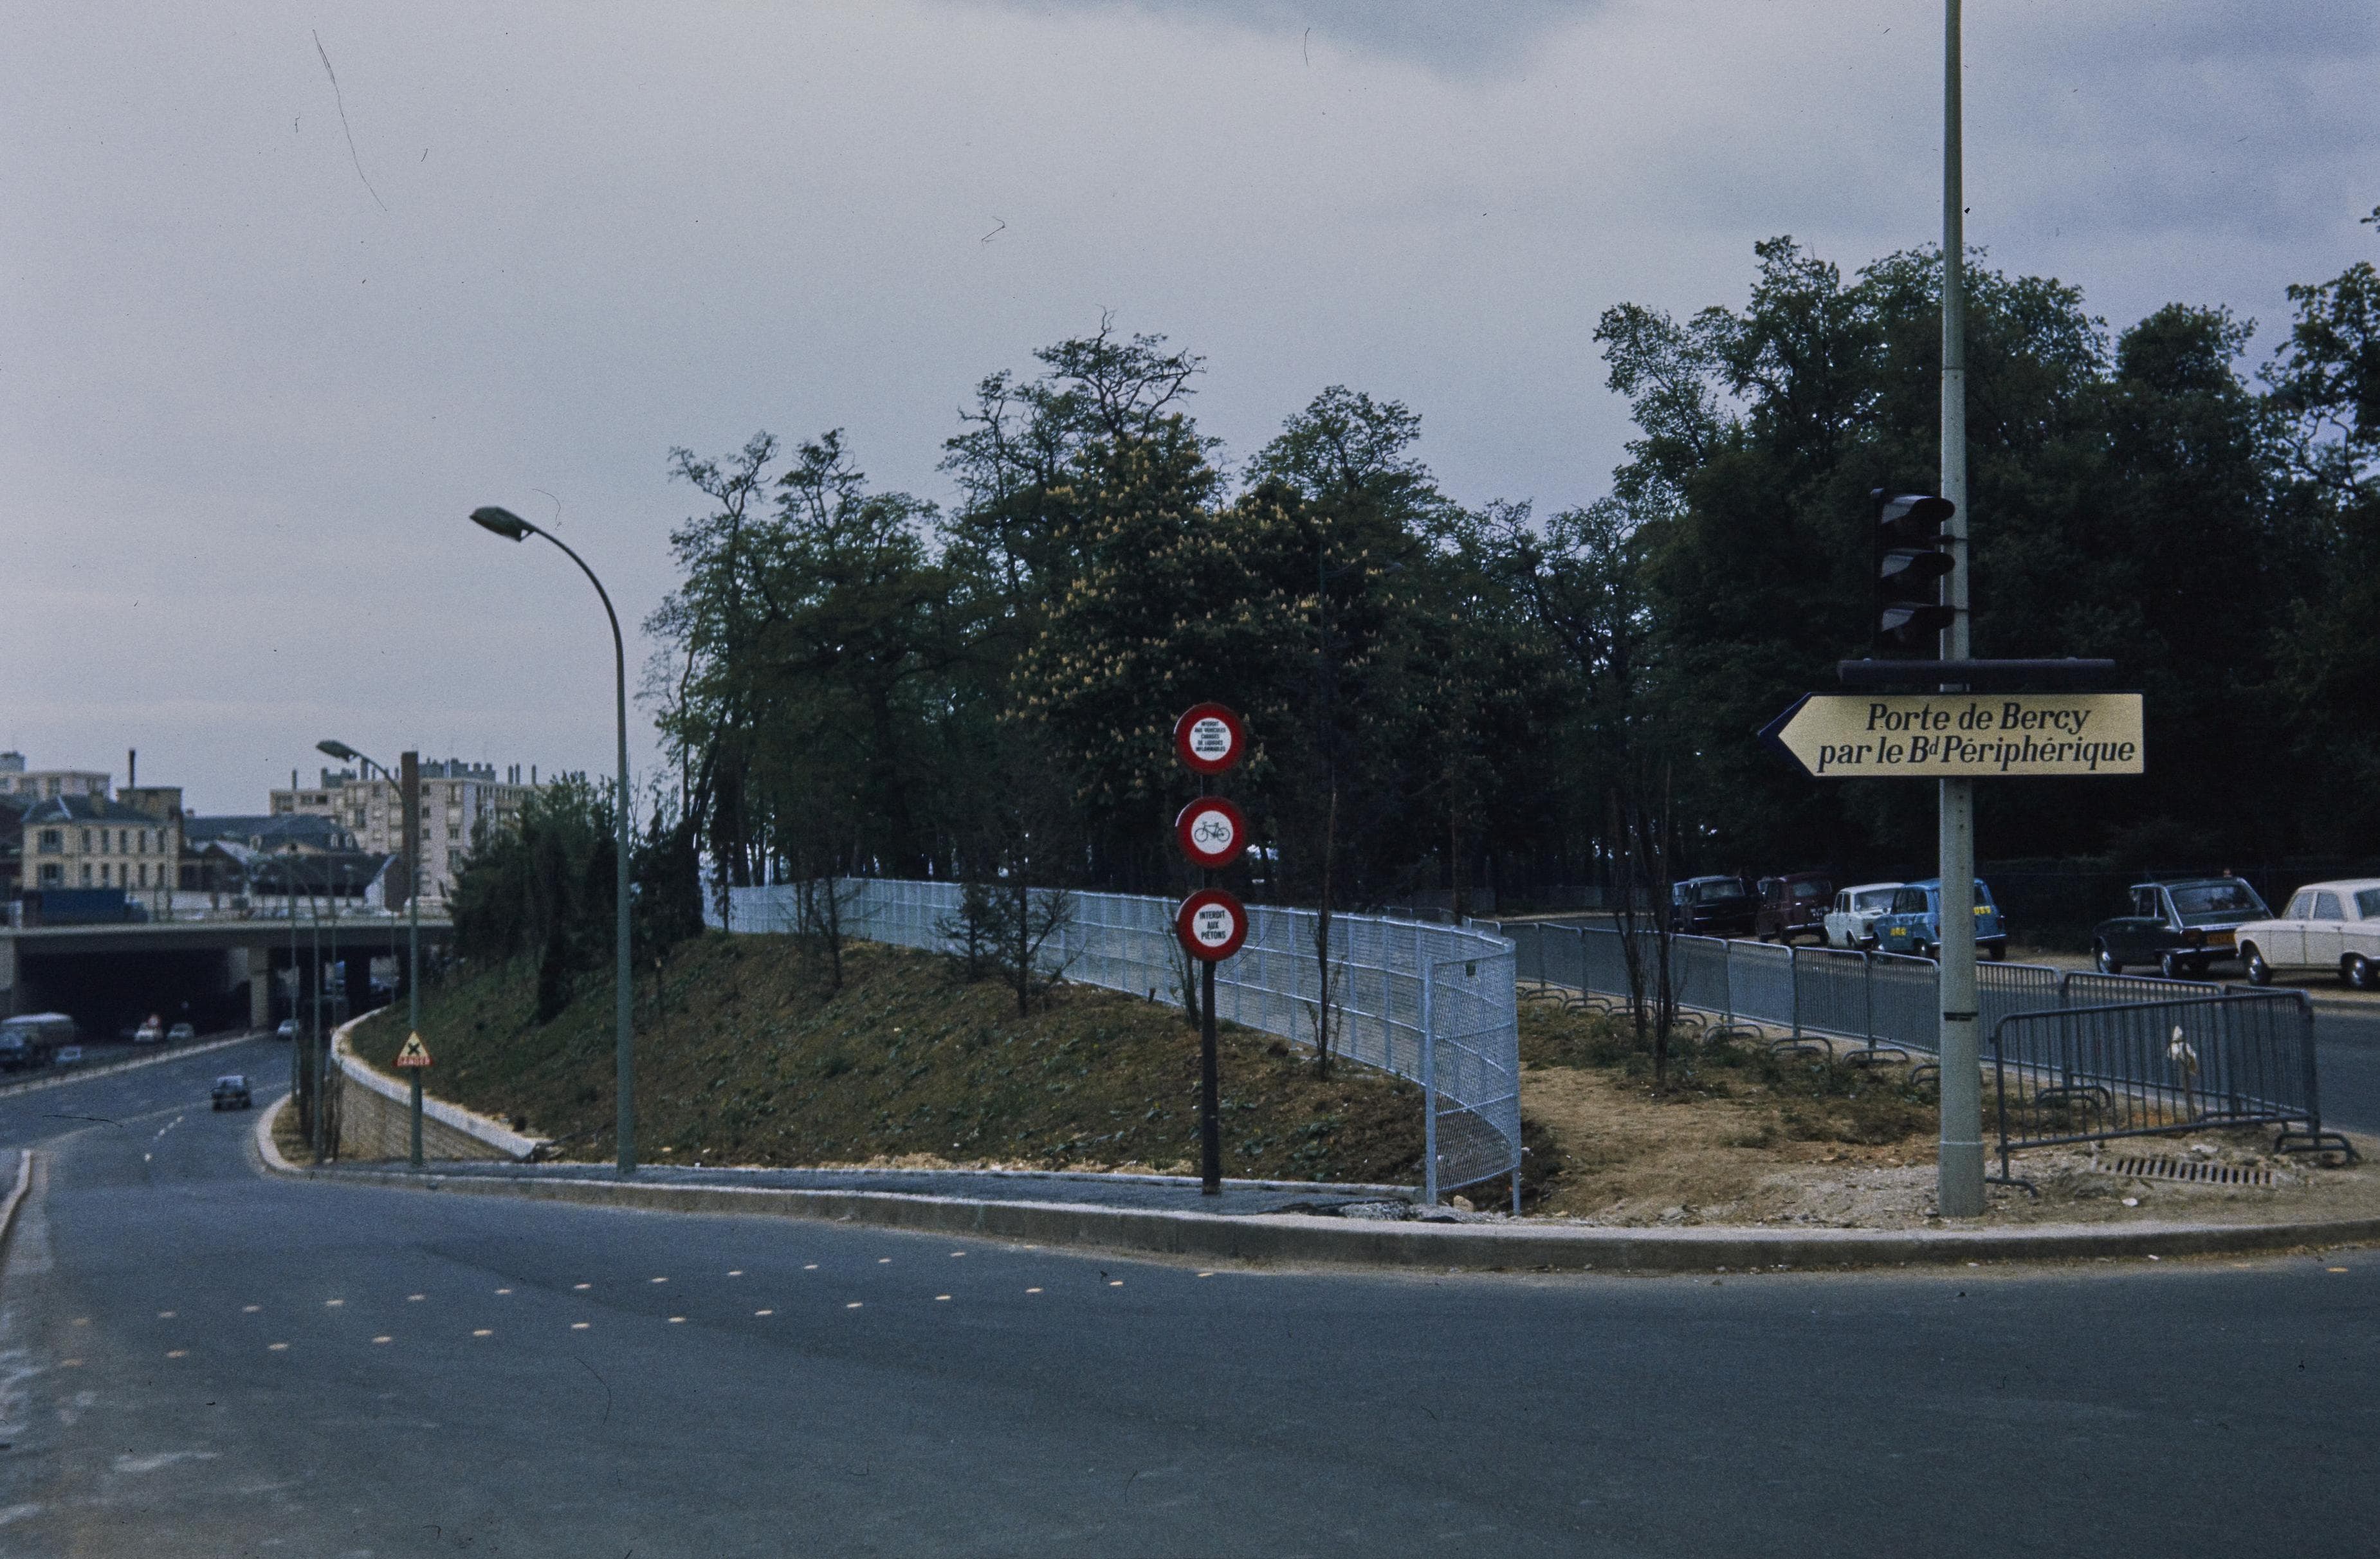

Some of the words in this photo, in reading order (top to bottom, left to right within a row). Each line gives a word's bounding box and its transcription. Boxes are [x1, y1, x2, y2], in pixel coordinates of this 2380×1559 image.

[1866, 703, 1950, 731] Porte
[1959, 702, 1993, 730] de
[2000, 702, 2091, 734] Bercy
[1818, 745, 1872, 773] par
[1878, 739, 1903, 764] le
[1908, 736, 1939, 763] Bd
[1941, 734, 2135, 772] Périphérique
[1199, 910, 1225, 919] INTERDIT
[1207, 921, 1219, 929] AUX
